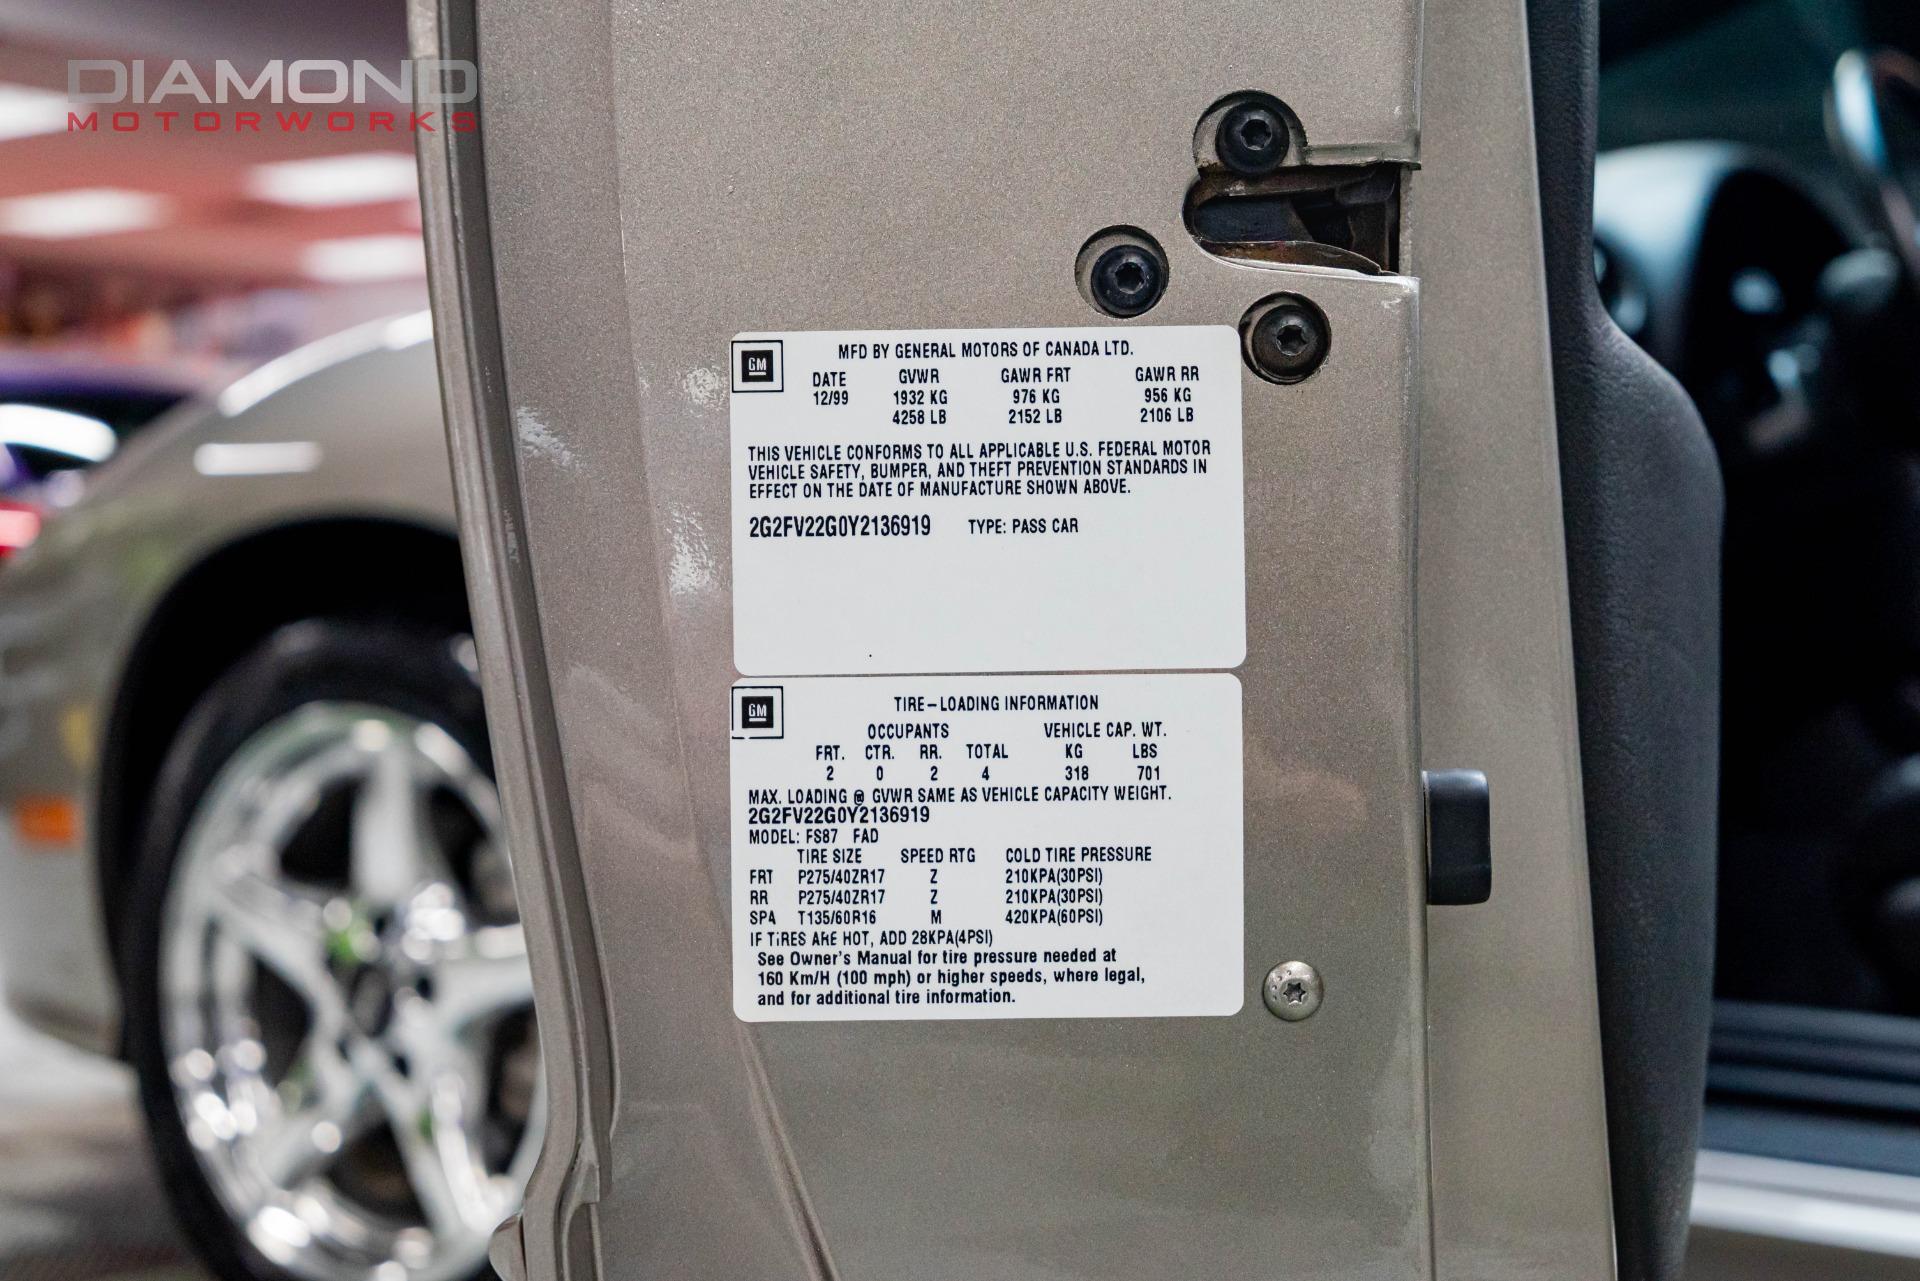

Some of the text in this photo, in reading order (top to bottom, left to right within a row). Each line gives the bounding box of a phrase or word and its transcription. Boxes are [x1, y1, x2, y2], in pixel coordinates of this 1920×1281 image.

[839, 340, 1133, 359] MFD BY GENERAL MOTORS OF CANADA LTD.
[748, 357, 767, 371] GM
[813, 372, 846, 387] DATE
[899, 368, 939, 384] GVWR
[1001, 367, 1071, 383] GAWR FRT
[1136, 366, 1199, 382] GAWR RR
[813, 390, 848, 405] 12/99
[894, 389, 947, 405] 1932 KG
[1013, 389, 1059, 404] 976 KG
[1145, 387, 1191, 403] 956 KG
[893, 409, 946, 425] 4258 LB
[1009, 408, 1062, 424] 2152 LB
[1141, 407, 1193, 422] 2106 LB
[748, 440, 1210, 461] THIS VEHICLE CONFORMS TO ALL APPLICABLE U.S. FEDERAL MOTOR
[749, 459, 1206, 480] VEHICLE SAFETY, BUMPER, AND THEFT PREVENTION STANDARDS IN
[750, 478, 1130, 498] EFFECT ON THE DATE OF MANUFACTURE SHOWN ABOVE.
[750, 514, 930, 538] 2G2FV22G0Y2136919
[968, 518, 1078, 534] TYPE: PASS CAR
[748, 703, 767, 717] GM
[1005, 695, 1098, 710] INFORMATION
[868, 723, 949, 739] OCCUPANTS
[1044, 722, 1166, 738] VEHICLE CAP. WT.
[816, 745, 844, 761] FRT.
[865, 745, 894, 760] CTR.
[920, 744, 941, 759] RR.
[966, 744, 1008, 759] TOTAL
[1066, 743, 1082, 758] KG
[1133, 743, 1157, 758] LBS
[827, 765, 834, 781] 2
[877, 766, 883, 781] 0
[931, 766, 938, 781] 2
[982, 766, 989, 780] 4
[1065, 765, 1088, 781] 318
[1137, 766, 1159, 780] 701
[749, 785, 1171, 806] MAX. LOADING @ GVWR SAME AS VEHICLE CAPACITY WEIGHT.
[749, 806, 929, 824] 2G2FV22G0Y2136919
[750, 828, 878, 844] MODEL: FS87 FAD
[797, 848, 861, 864] TIRE SIZE
[901, 848, 975, 863] SPEED RTG
[1006, 846, 1151, 863] COLD TIRE PRESSURE
[750, 869, 773, 884] FRT
[799, 869, 884, 885] P275/40ZR17
[930, 869, 937, 884] Z
[1006, 868, 1102, 886] 210KPA(30PSI)
[750, 890, 768, 905] RR
[799, 889, 885, 905] P275/40ZR17
[931, 889, 937, 904] Z
[1006, 888, 1102, 906] 210KPA(30PSI)
[750, 910, 776, 925] SPA
[798, 910, 876, 925] T135/60R16
[931, 910, 941, 924] M
[1005, 909, 1102, 926] 420KPA(60PSI)
[751, 932, 762, 946] IF
[812, 931, 837, 946] ARE
[843, 931, 873, 948] HOT,
[880, 930, 906, 945] ADD
[912, 929, 992, 948] 28KPA(4PSI)
[758, 948, 1116, 967] See Owner's Manual for tire pressure needed at
[758, 967, 1144, 988] 160 Km/H (100 mph) or higher speeds, where legal,
[758, 988, 1015, 1005] and for additional tire information.
